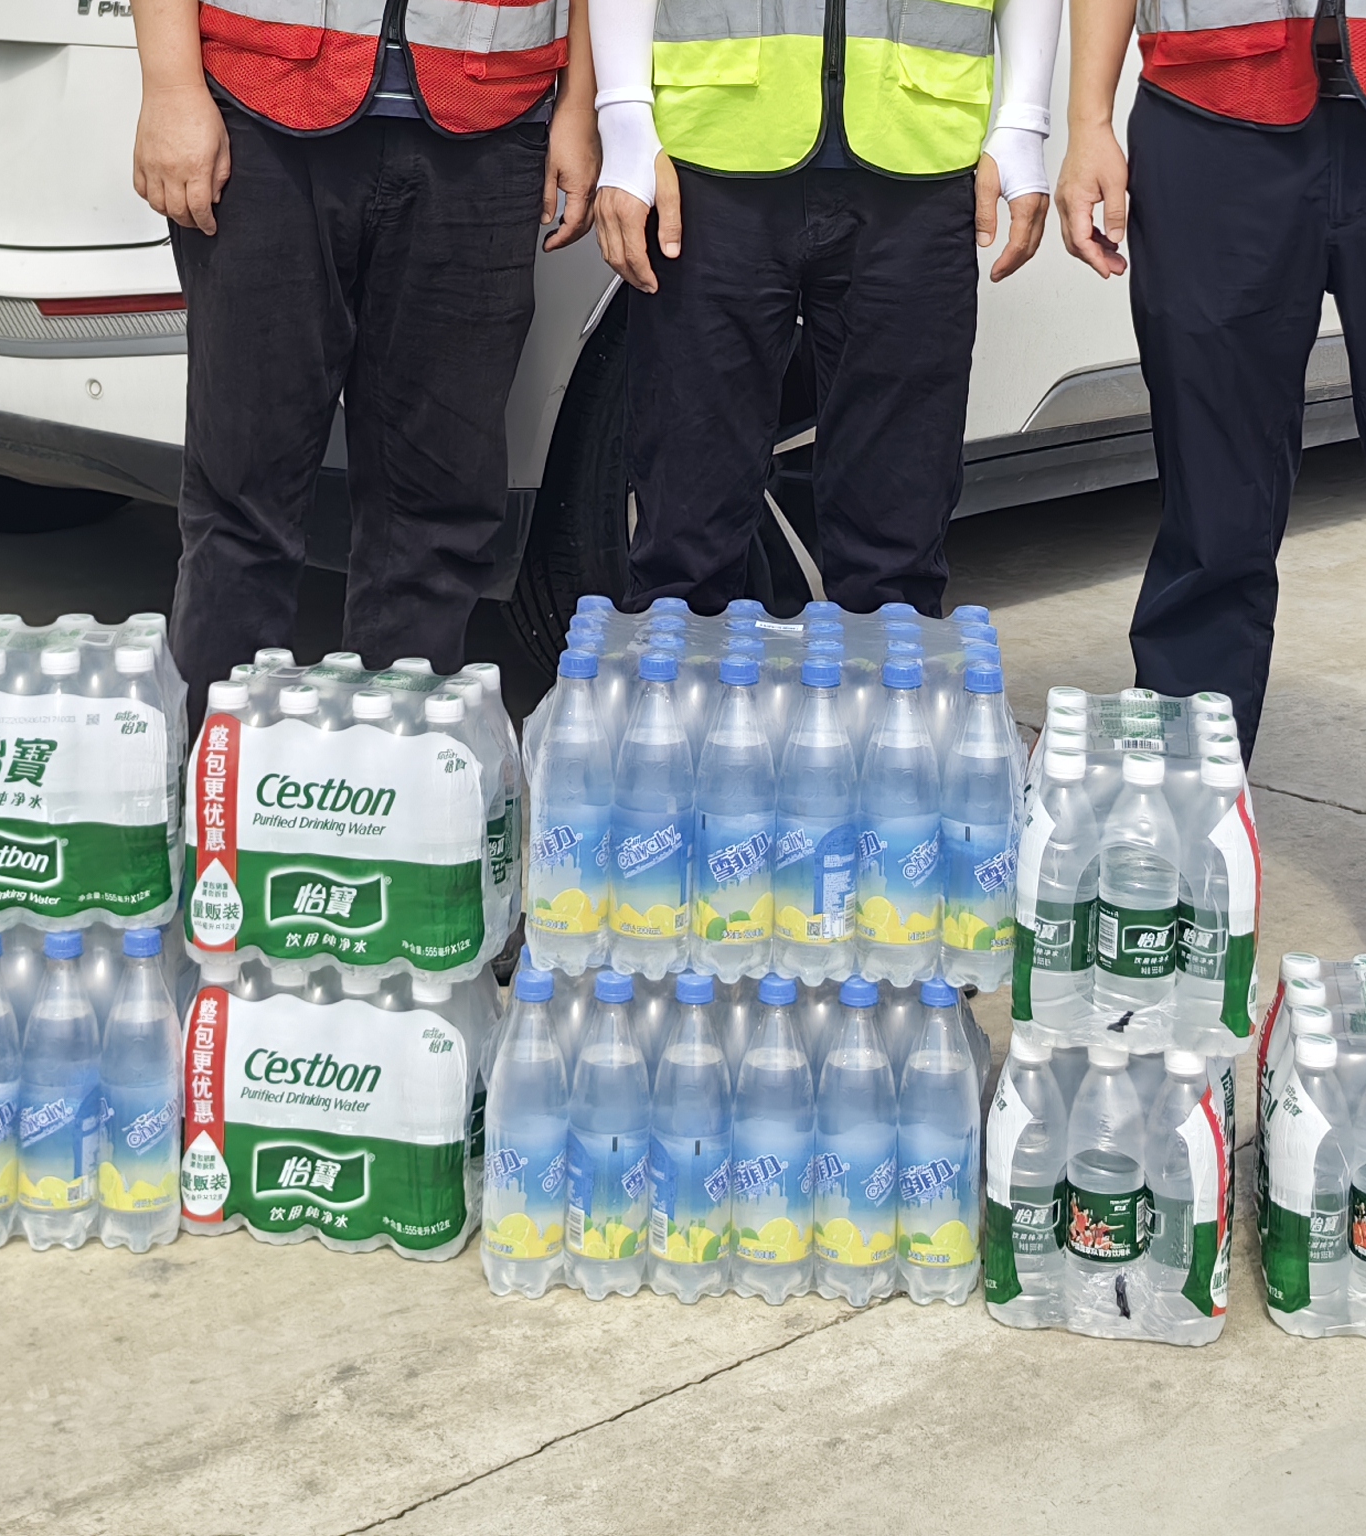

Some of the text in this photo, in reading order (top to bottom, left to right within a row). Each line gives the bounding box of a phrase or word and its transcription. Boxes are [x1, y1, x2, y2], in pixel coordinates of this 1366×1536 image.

[202, 724, 231, 852] 整包更优惠
[252, 813, 387, 837] Purified Drinking Water
[28, 893, 62, 906] Water
[191, 996, 218, 1124] 整包更优惠
[240, 1086, 371, 1113] Purified Drinking Water
